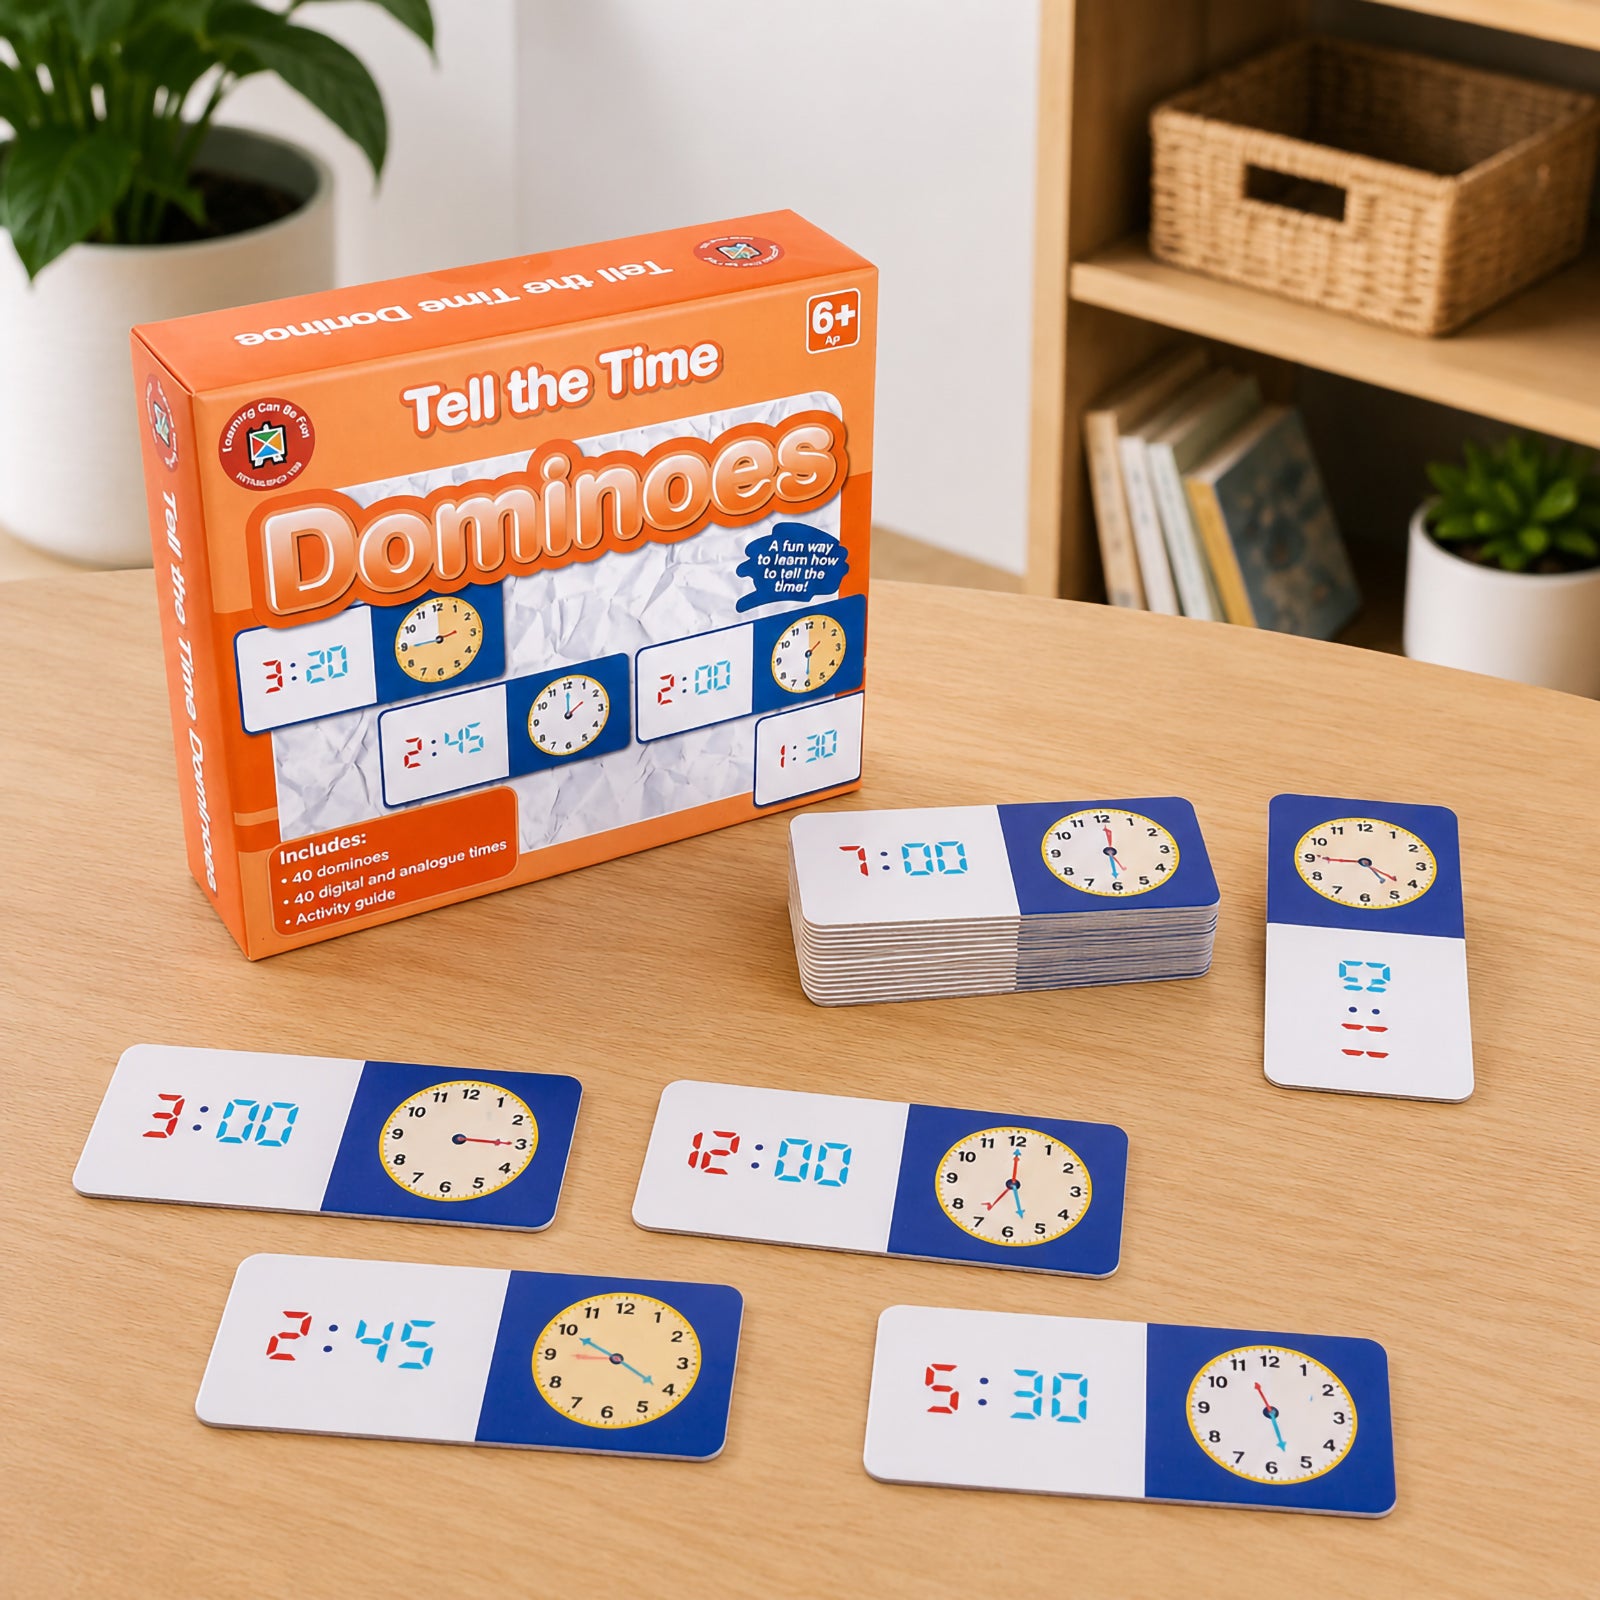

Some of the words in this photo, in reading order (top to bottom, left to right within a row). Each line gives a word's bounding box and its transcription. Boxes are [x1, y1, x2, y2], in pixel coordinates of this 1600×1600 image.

[597, 259, 674, 282] Tell
[523, 275, 594, 294] the
[418, 287, 521, 313] Time
[812, 300, 856, 334] 6+
[403, 374, 495, 432] Tell
[507, 366, 589, 411] the
[599, 343, 719, 394] Time
[258, 402, 281, 413] Can
[262, 422, 838, 615] Dominoes
[768, 540, 779, 552] A
[782, 539, 804, 552] fun
[807, 543, 834, 555] way
[757, 553, 771, 565] to
[810, 554, 839, 566] how
[764, 567, 777, 579] to
[804, 568, 826, 580] the
[432, 603, 443, 613] 12
[453, 604, 458, 613] 1
[416, 611, 426, 620] 11
[464, 612, 471, 621] 2
[405, 624, 417, 635] 10
[805, 621, 814, 630] 12
[822, 621, 826, 629] 1
[470, 628, 477, 637] 3
[791, 628, 799, 637] 11
[831, 628, 838, 637] 2
[401, 642, 408, 652] 9
[781, 640, 791, 649] 10
[263, 645, 348, 693] 3:20
[454, 660, 461, 668] 5
[420, 667, 427, 677] 7
[437, 667, 445, 676] 6
[819, 672, 825, 680] 5
[582, 681, 586, 690] 1
[657, 660, 730, 704] 2:00
[791, 679, 797, 687] 7
[804, 679, 811, 687] 6
[548, 689, 556, 698] 11
[592, 689, 599, 698] 2
[537, 701, 548, 711] 10
[597, 703, 604, 712] 3
[592, 720, 599, 728] 4
[582, 733, 588, 742] 5
[403, 722, 484, 768] 2:45
[551, 741, 557, 750] 7
[565, 741, 572, 750] 6
[780, 730, 837, 768] 1:30
[1071, 820, 1084, 828] 11
[1093, 815, 1111, 824] 12
[1126, 818, 1134, 826] 1
[1147, 827, 1158, 837] 2
[1331, 826, 1344, 835] 11
[1357, 823, 1373, 833] 12
[1055, 831, 1071, 840] 10
[1389, 831, 1396, 839] 1
[1311, 837, 1328, 847] 10
[279, 832, 367, 865] Includes:
[1051, 849, 1061, 858] 9
[1160, 845, 1170, 854] 3
[1408, 844, 1419, 853] 2
[840, 841, 968, 876] 7:00
[1304, 853, 1315, 863] 9
[292, 869, 313, 884] 40
[316, 850, 390, 877] dominoes
[294, 890, 315, 905] 40
[318, 876, 364, 898] digital
[368, 868, 395, 886] and
[399, 850, 465, 878] analogue
[468, 840, 507, 859] times
[1064, 867, 1074, 876] 8
[1155, 863, 1166, 873] 4
[1416, 862, 1427, 871] 3
[1139, 876, 1150, 885] 5
[1312, 871, 1323, 881] 8
[1084, 878, 1095, 887] 7
[1112, 882, 1124, 891] 6
[1407, 879, 1418, 889] 4
[1332, 885, 1343, 895] 7
[1389, 890, 1400, 900] 5
[1359, 893, 1371, 903] 6
[295, 900, 351, 926] Activity
[354, 888, 396, 912] guide
[433, 1091, 448, 1103] 11
[462, 1088, 481, 1100] 12
[497, 1097, 504, 1108] 1
[408, 1106, 426, 1118] 10
[143, 1093, 299, 1147] 3:00
[512, 1114, 524, 1126] 2
[392, 1128, 404, 1140] 9
[514, 1138, 527, 1150] 3
[981, 1137, 994, 1149] 11
[1008, 1135, 1027, 1147] 12
[1044, 1144, 1052, 1156] 1
[393, 1154, 406, 1165] 8
[688, 1130, 852, 1187] 12:00
[958, 1151, 976, 1163] 10
[498, 1162, 511, 1174] 4
[1062, 1162, 1074, 1174] 2
[412, 1172, 424, 1184] 7
[472, 1176, 485, 1189] 5
[946, 1172, 958, 1184] 9
[439, 1181, 452, 1193] 6
[1070, 1186, 1082, 1197] 3
[952, 1198, 964, 1209] 8
[1057, 1209, 1070, 1220] 4
[973, 1216, 984, 1228] 7
[1002, 1226, 1014, 1238] 6
[1034, 1223, 1046, 1235] 5
[584, 1307, 600, 1319] 11
[616, 1302, 635, 1315] 12
[654, 1311, 661, 1323] 1
[559, 1323, 578, 1336] 10
[266, 1311, 435, 1370] 2:45
[671, 1330, 683, 1343] 2
[544, 1348, 557, 1361] 9
[676, 1357, 689, 1370] 3
[1230, 1359, 1246, 1372] 11
[1260, 1355, 1280, 1368] 12
[1299, 1364, 1307, 1377] 1
[549, 1375, 562, 1389] 8
[1208, 1376, 1228, 1389] 10
[662, 1383, 675, 1396] 4
[925, 1363, 1088, 1424] 5:30
[1322, 1384, 1335, 1397] 2
[571, 1396, 583, 1409] 7
[636, 1400, 649, 1413] 5
[1198, 1401, 1210, 1414] 9
[601, 1405, 614, 1419] 6
[1333, 1411, 1345, 1425] 3
[1208, 1430, 1221, 1443] 8
[1322, 1439, 1336, 1452] 4
[1232, 1451, 1245, 1464] 7
[1300, 1456, 1313, 1469] 5
[1265, 1461, 1278, 1474] 6
